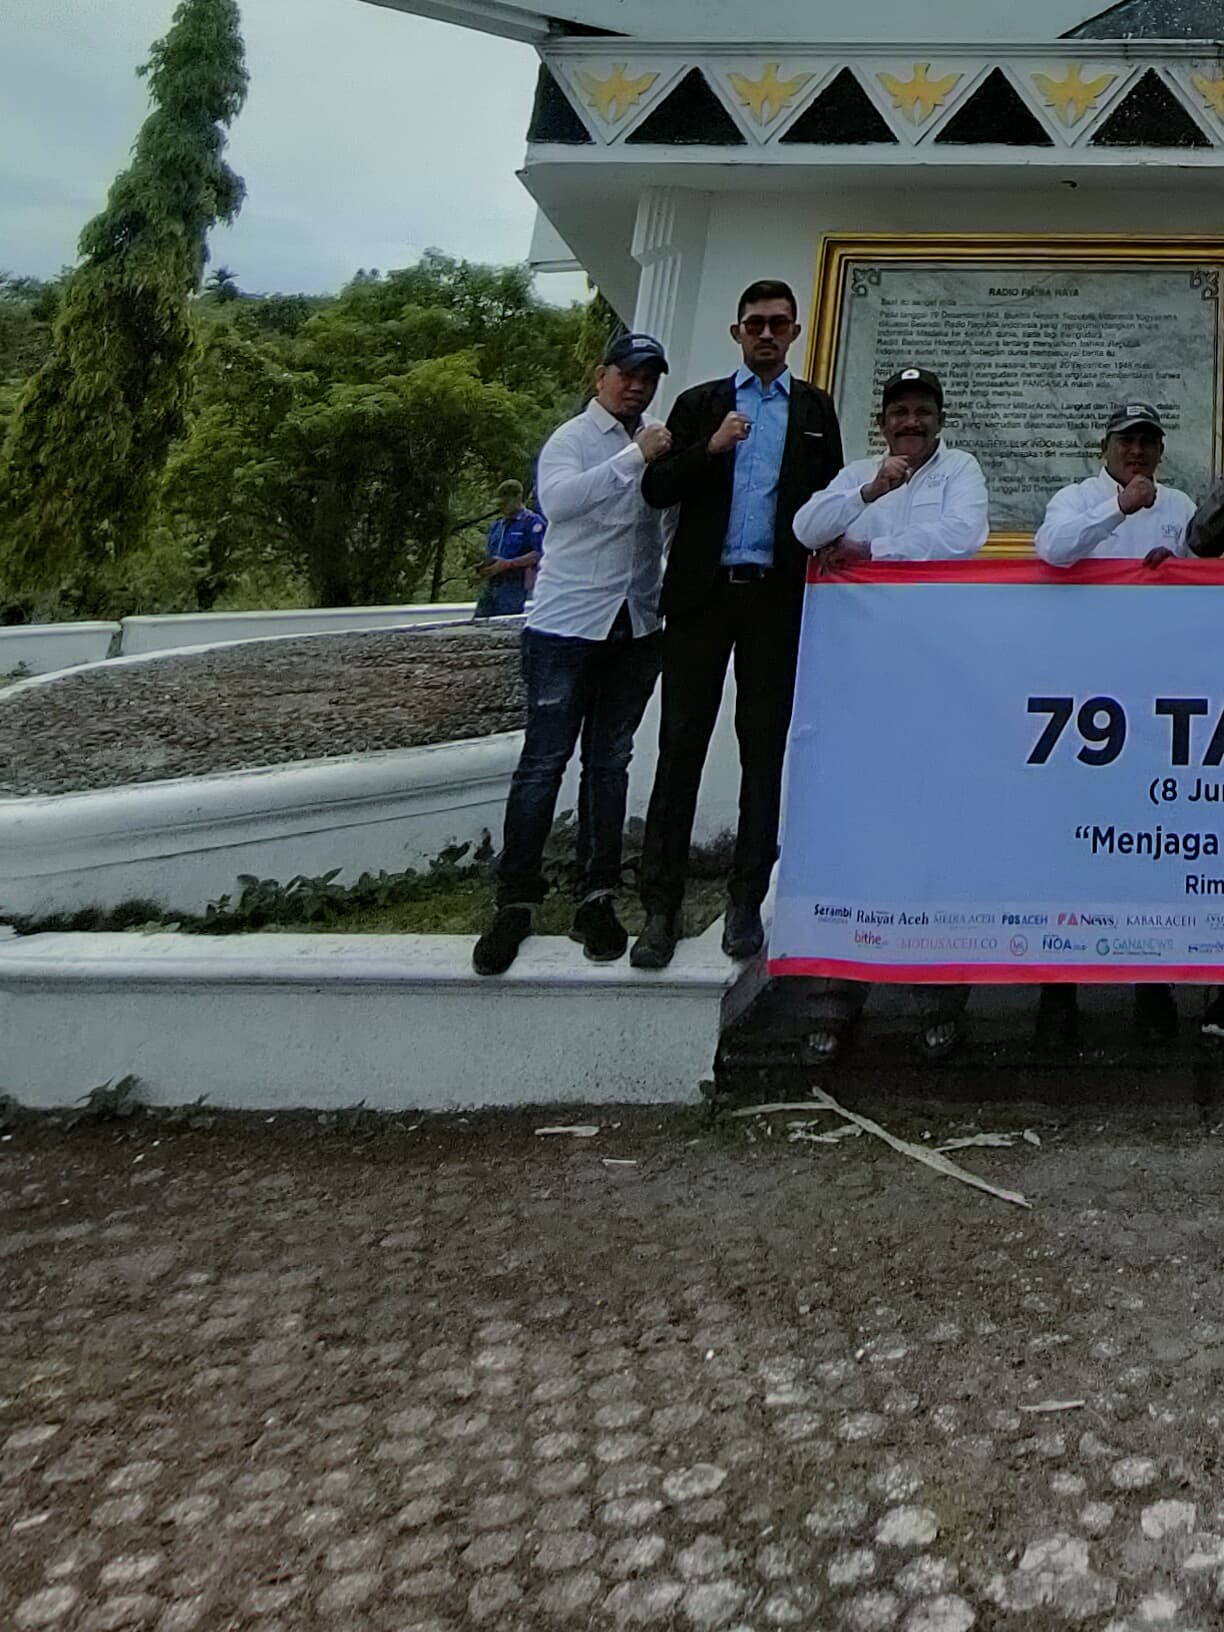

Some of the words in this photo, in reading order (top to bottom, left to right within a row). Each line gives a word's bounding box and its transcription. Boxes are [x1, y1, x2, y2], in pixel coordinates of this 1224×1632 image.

[1026, 695, 1127, 768] 79
[1148, 778, 1178, 806] (8
[1075, 824, 1220, 862] “Menjaga
[814, 904, 852, 919] Serambi
[856, 910, 894, 927] Rakyat
[898, 912, 929, 926] Aceh
[1126, 915, 1162, 927] KABAR
[1164, 915, 1196, 927] ACEH
